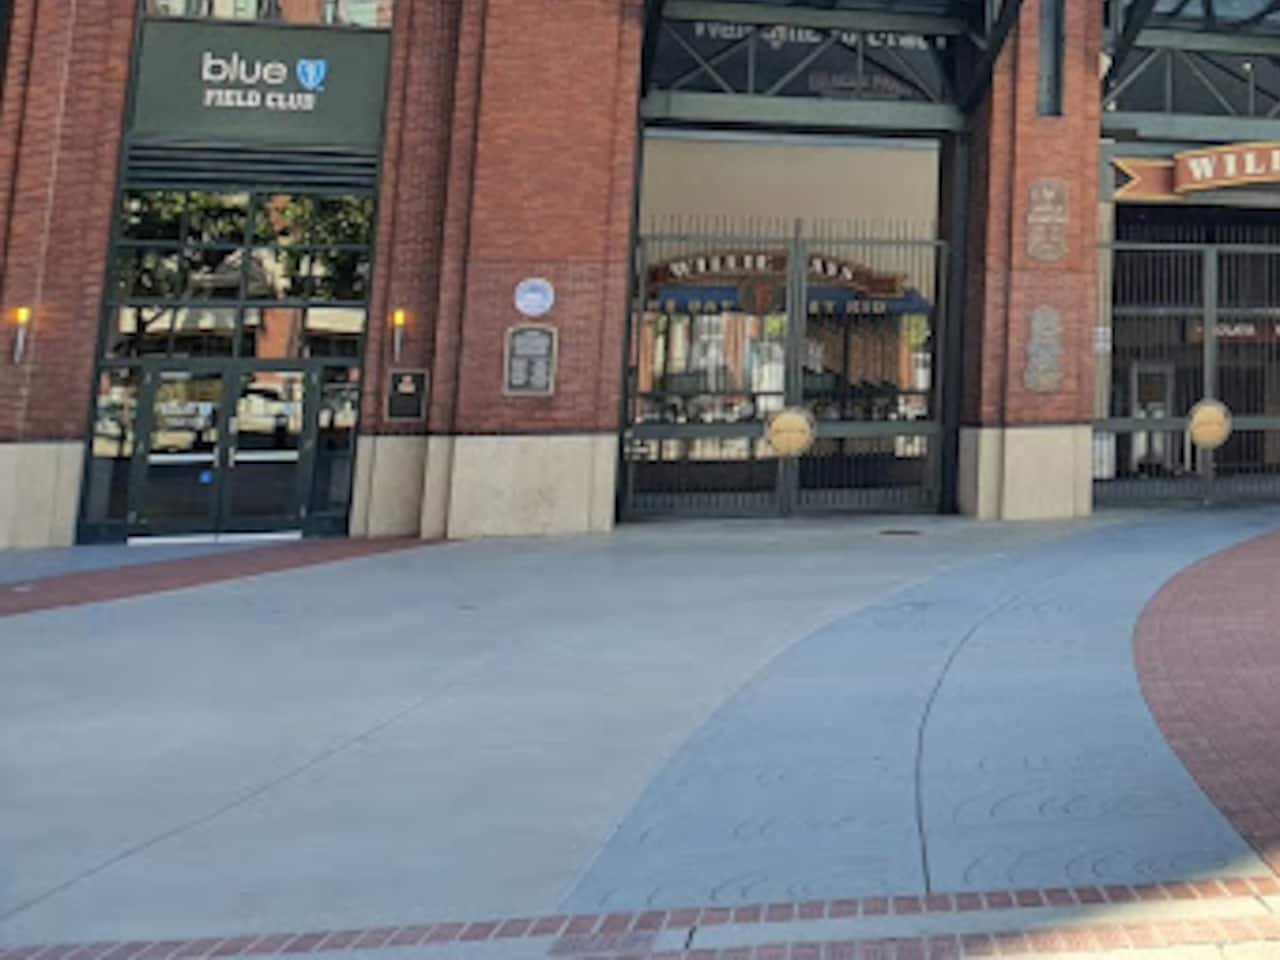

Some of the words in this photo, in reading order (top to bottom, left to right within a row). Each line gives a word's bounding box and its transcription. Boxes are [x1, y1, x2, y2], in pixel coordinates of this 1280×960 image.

[201, 50, 289, 85] blue
[203, 88, 262, 108] FIELD
[264, 91, 317, 111] CLUB
